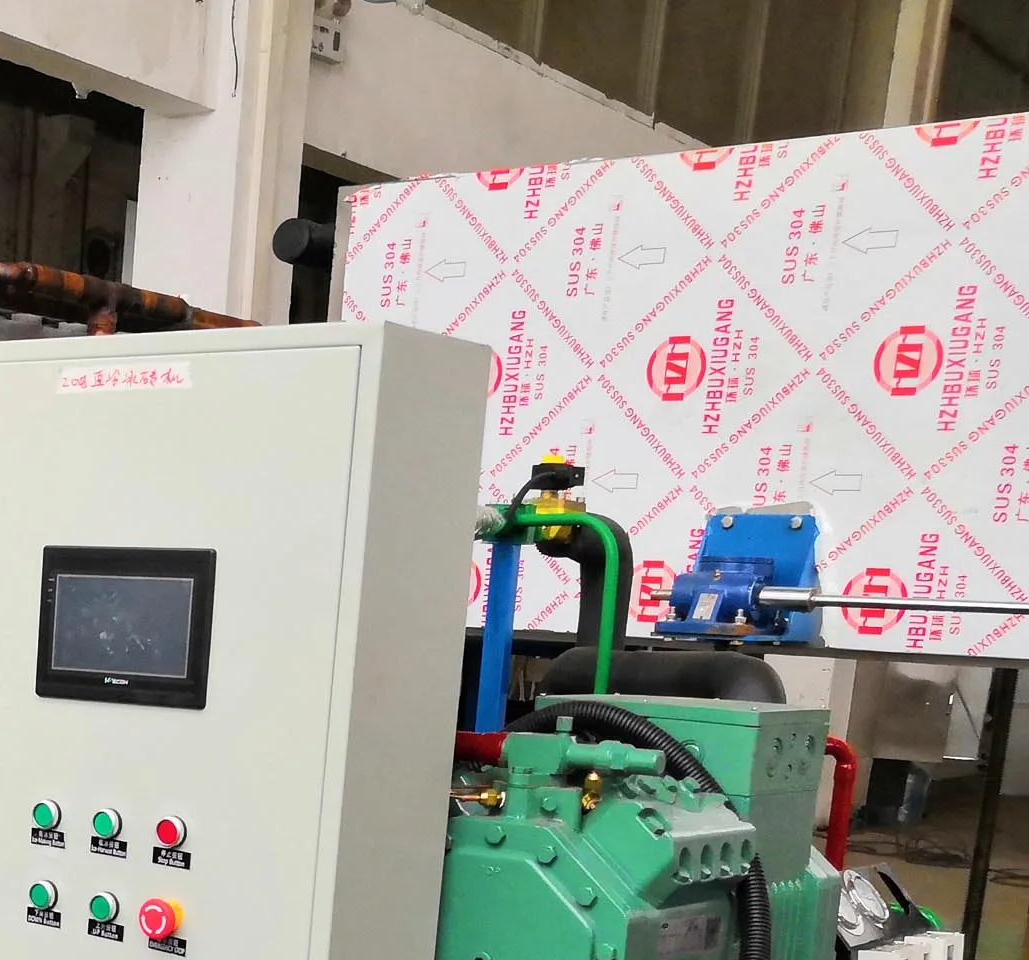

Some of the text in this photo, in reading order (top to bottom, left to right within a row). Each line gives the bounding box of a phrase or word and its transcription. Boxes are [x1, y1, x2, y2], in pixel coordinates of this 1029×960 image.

[652, 177, 714, 250] HZHBUXIUGANG
[721, 208, 761, 248] SUS304
[885, 158, 954, 232] HZHBUXIUGANG
[962, 189, 1010, 229] SUS304
[456, 199, 508, 264] HZHBUXIUGANG
[513, 226, 548, 263] SUS304
[567, 226, 586, 297] SUS 304
[781, 208, 805, 285] SUS 304
[961, 237, 996, 275] SUS304
[380, 241, 397, 308] SUS 304
[636, 255, 712, 333] HZHBUXIUGANG
[718, 255, 814, 362] HZHBUXIUGANG SUS304
[861, 240, 951, 321] HZHBUXIUGANG
[511, 269, 594, 368] HZHBUXIUGANG SUS304
[599, 331, 635, 369] SUS304
[820, 321, 861, 360] SUS304
[499, 310, 526, 436] HZHBUXIUGANG
[534, 345, 548, 400] SUS 304
[598, 373, 626, 410] SUS304
[702, 298, 735, 435] HZHBUXIUGANG
[743, 336, 760, 396] SUS 304
[815, 367, 850, 406] SUS304
[937, 284, 978, 432] HZHBUXIUGANG
[986, 326, 1005, 390] SUS 304
[522, 375, 592, 446] HZHBUXIUGANG
[624, 407, 685, 479] HZHBUXIUGANG
[847, 403, 917, 480] HZHBUXIUGANG
[489, 446, 523, 478] SUS304
